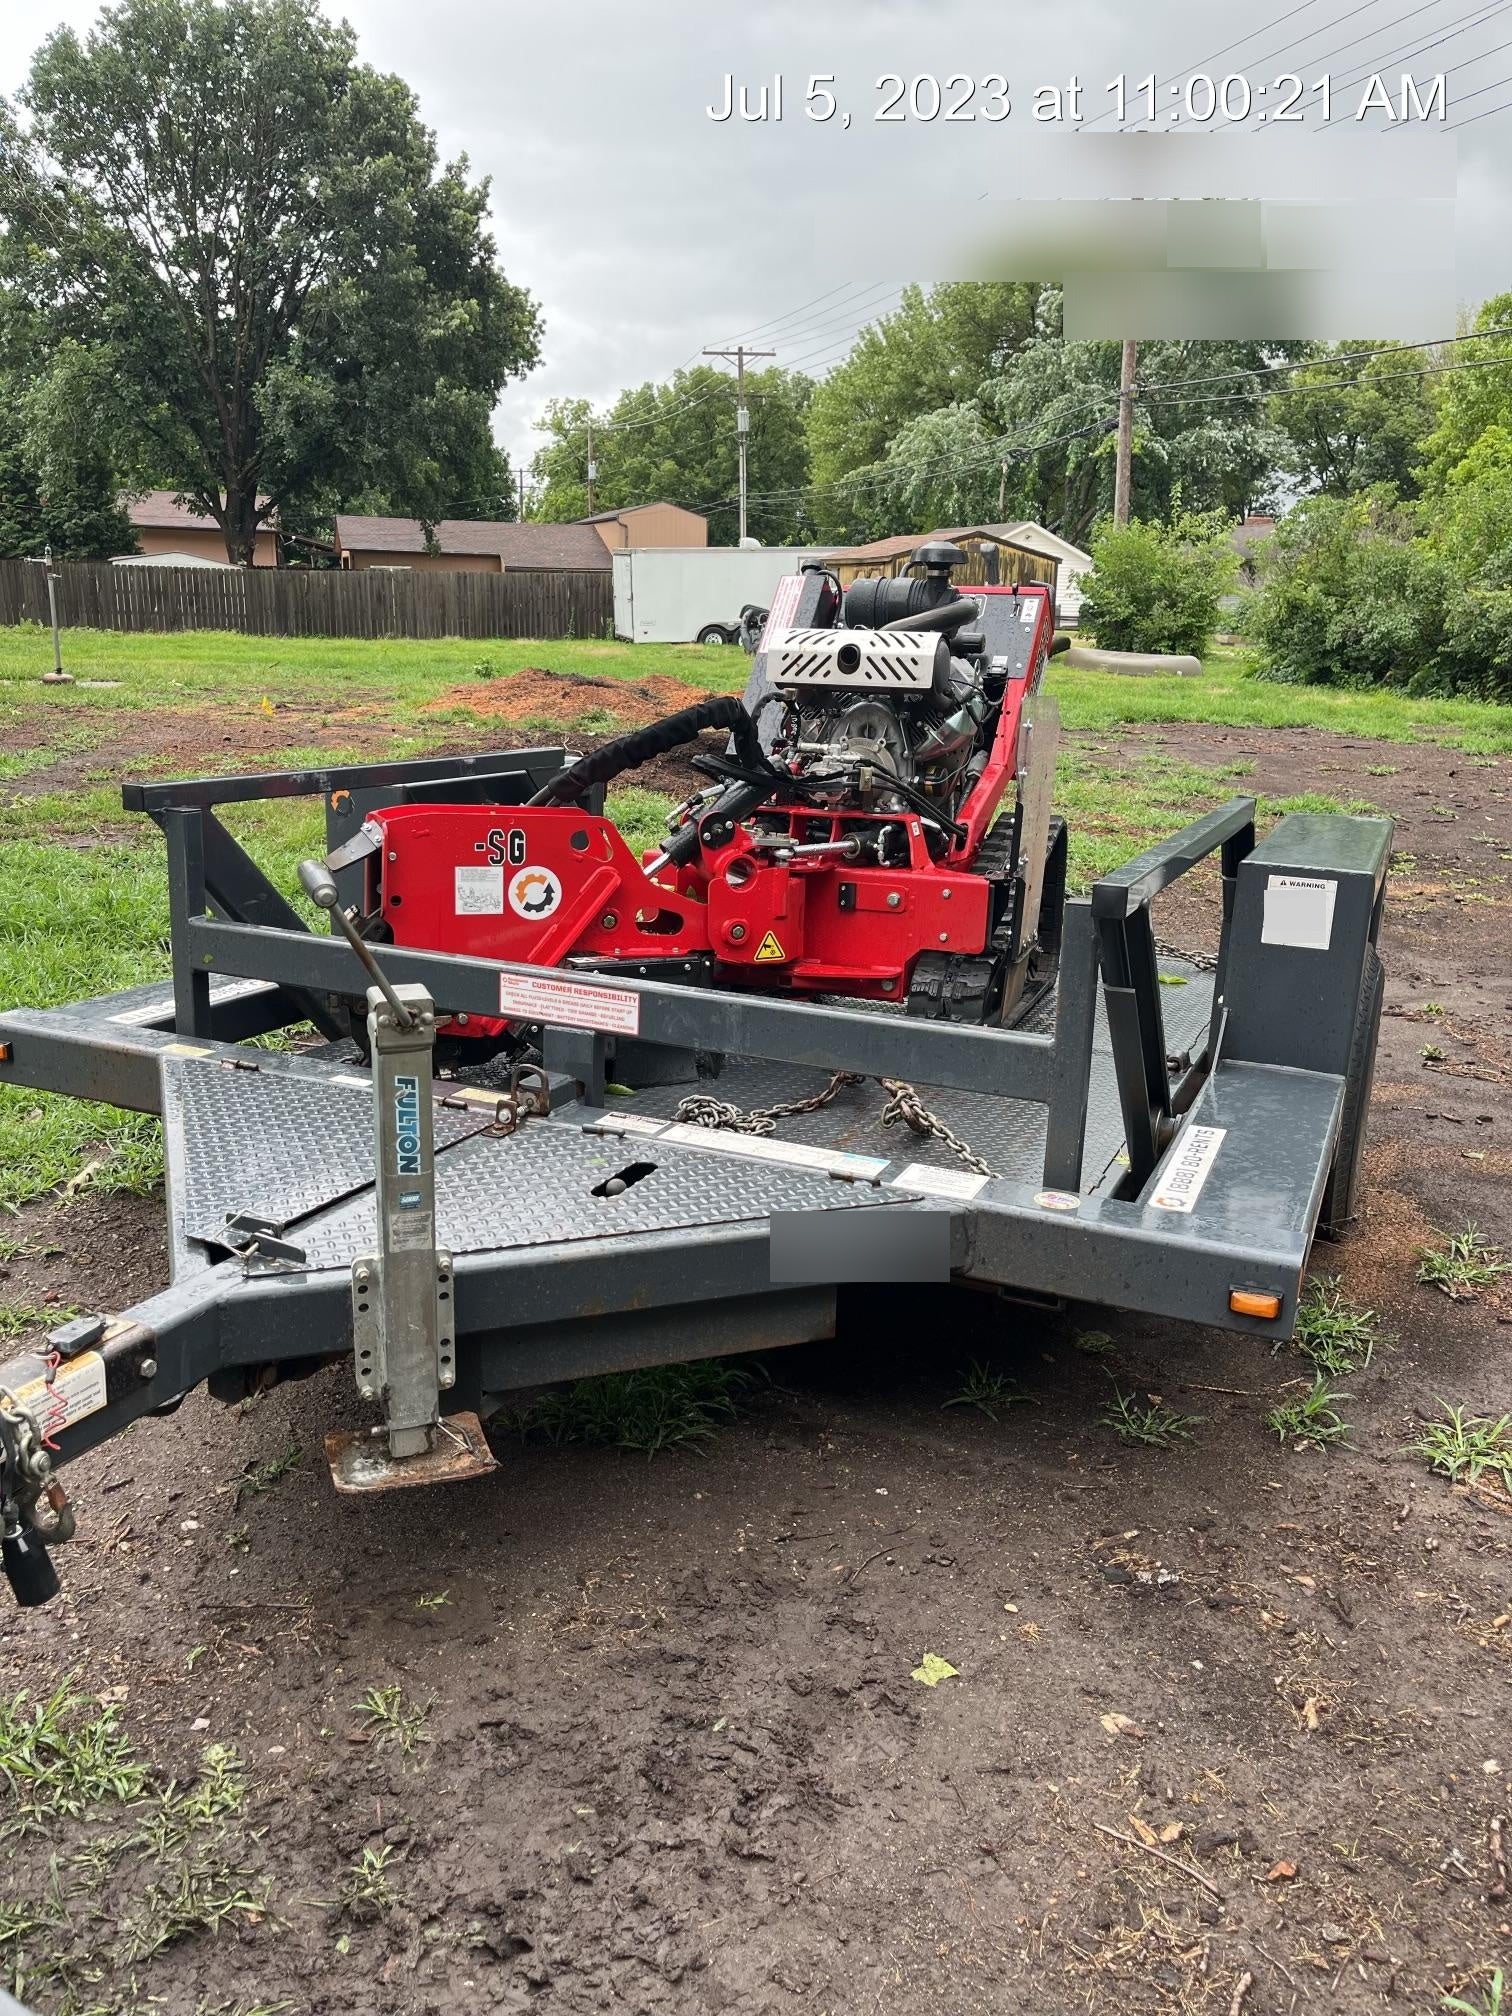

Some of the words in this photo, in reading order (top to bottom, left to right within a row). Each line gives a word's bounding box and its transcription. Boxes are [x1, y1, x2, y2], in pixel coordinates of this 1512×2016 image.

[1289, 881, 1326, 890] WARNING
[531, 981, 572, 993] CUSTOMER
[573, 988, 637, 1003] RESPONSIBILITY
[395, 1076, 421, 1175] FULTON
[1165, 1168, 1198, 1193] (888)
